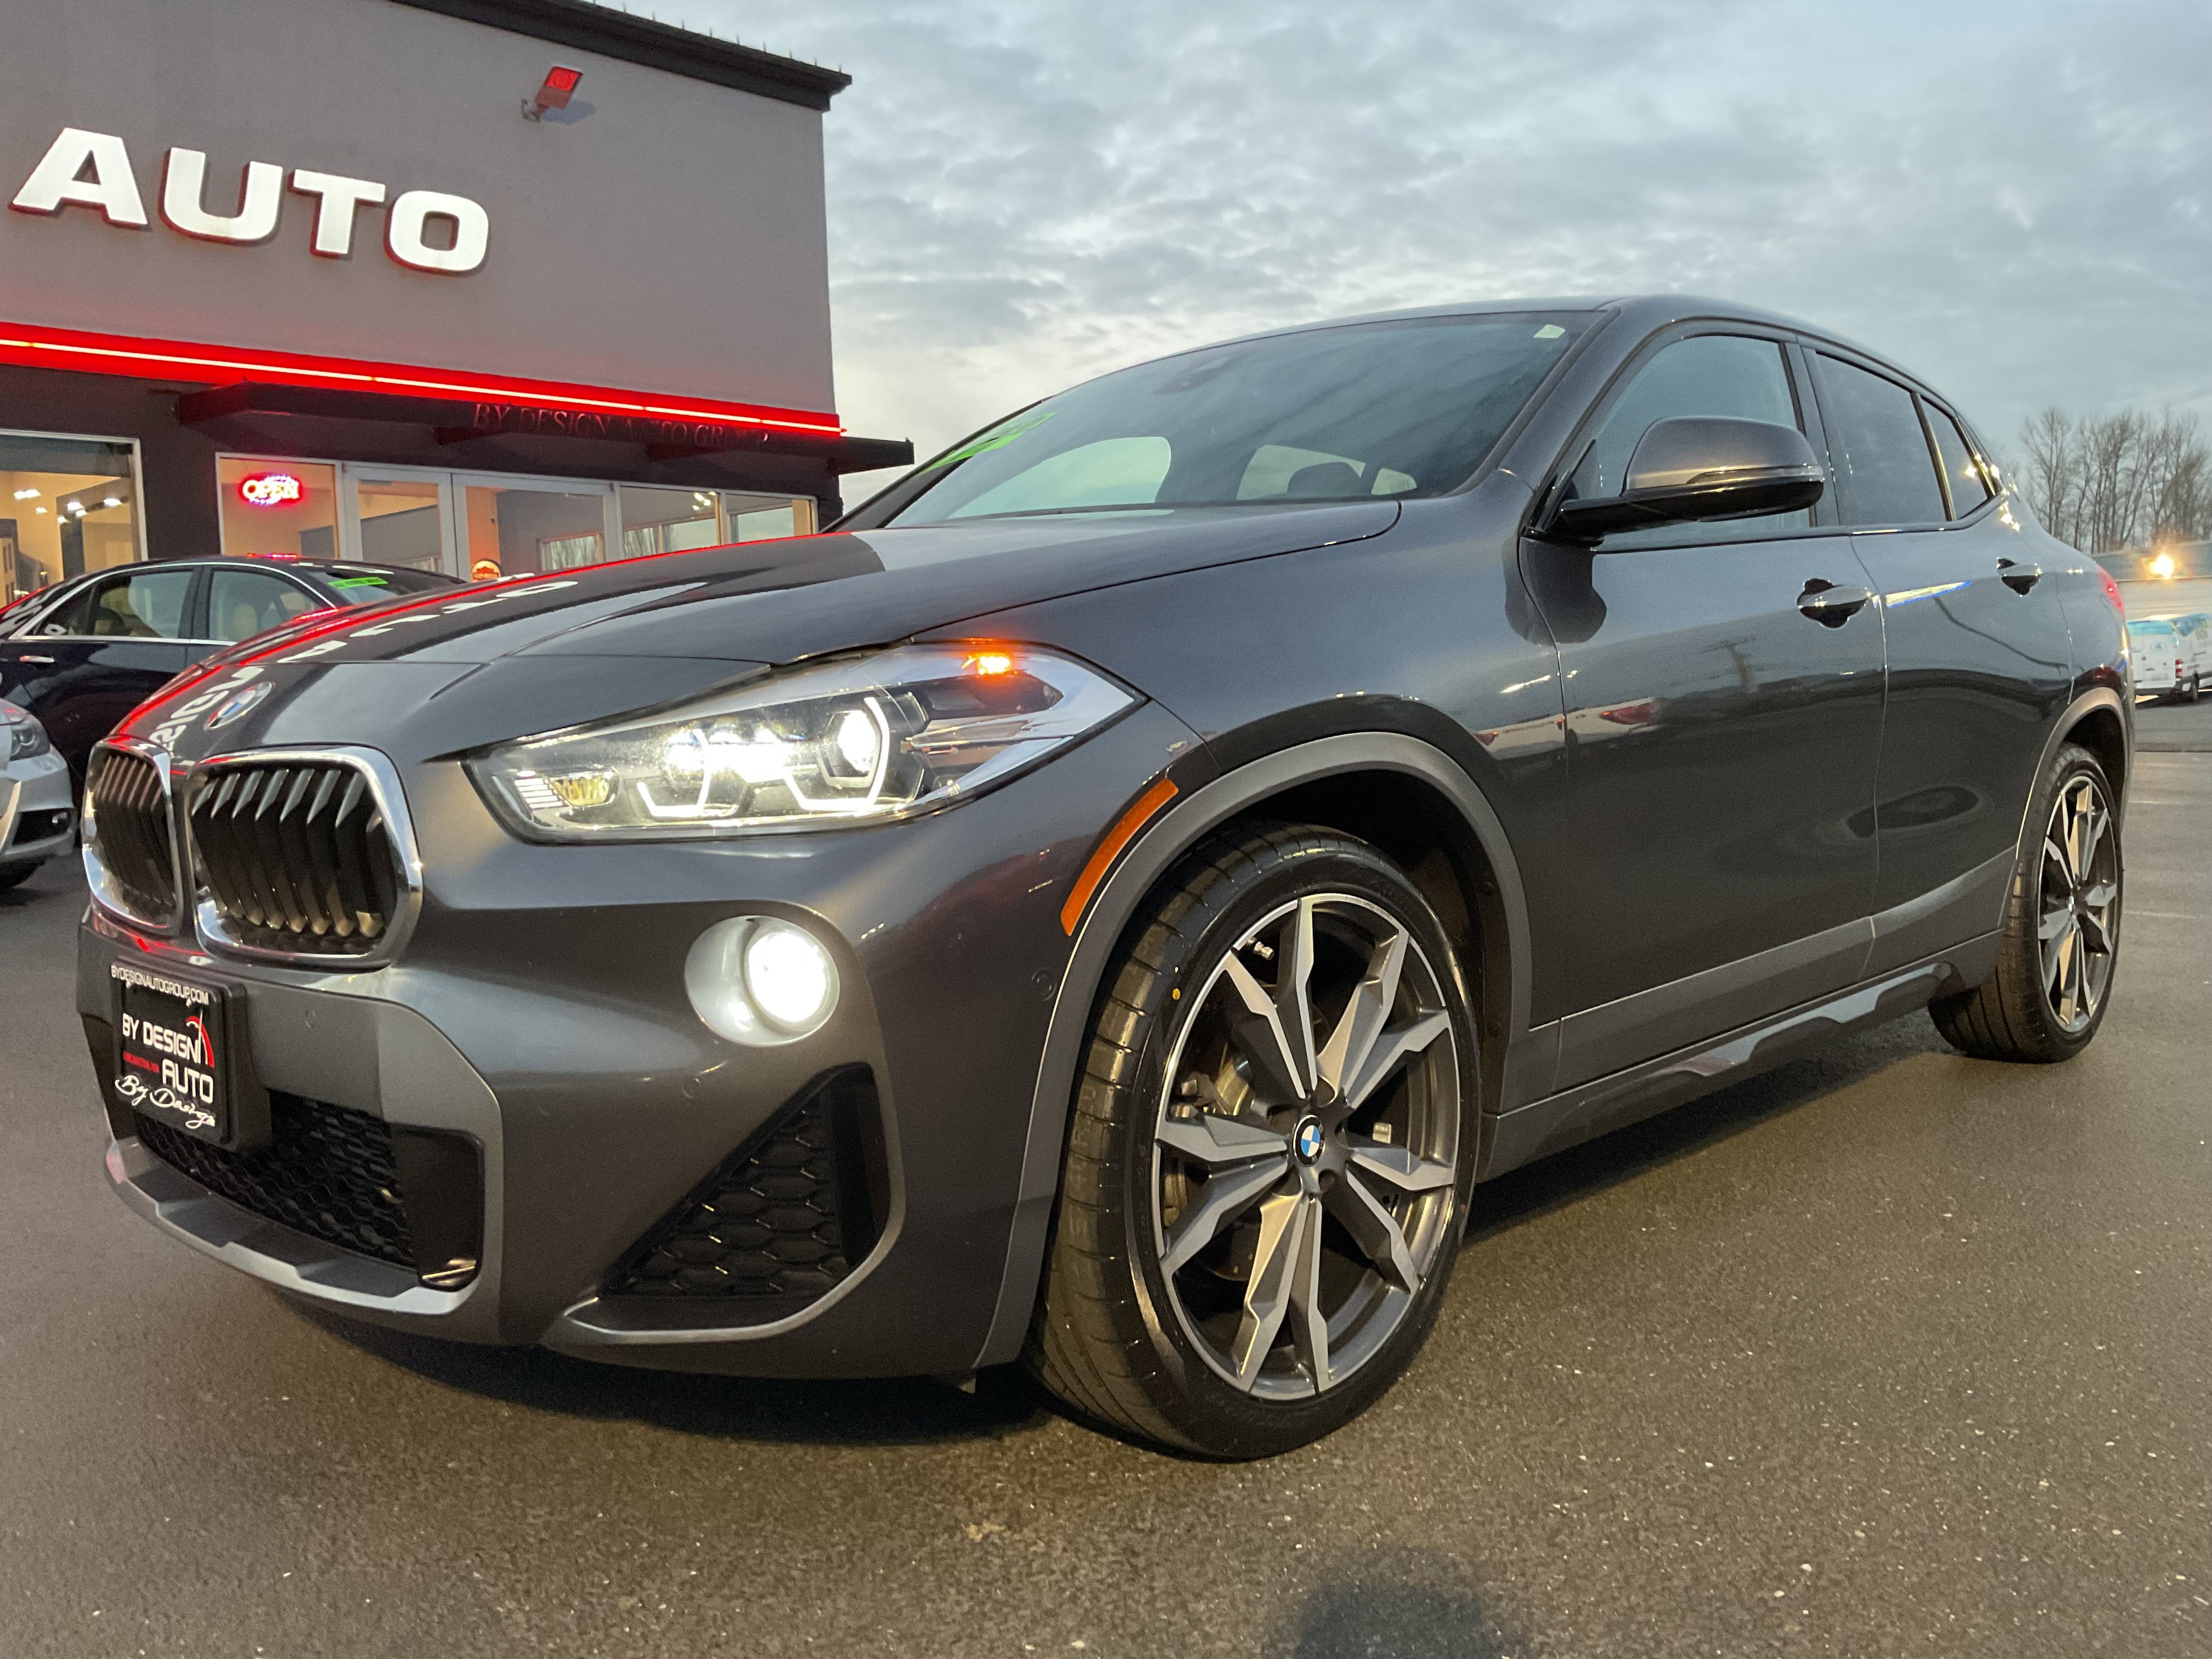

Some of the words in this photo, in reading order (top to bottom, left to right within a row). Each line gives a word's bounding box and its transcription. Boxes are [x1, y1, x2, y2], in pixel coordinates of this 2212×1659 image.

[9, 127, 490, 273] AUTO
[473, 403, 511, 430] BY
[622, 418, 688, 444] ATO
[242, 477, 300, 500] OPEN
[111, 965, 210, 1006] BYDESIGNAUTOGROUP.COM
[122, 1013, 140, 1040] BY
[143, 1020, 200, 1063] DESIGN
[162, 1058, 214, 1104] AUTO
